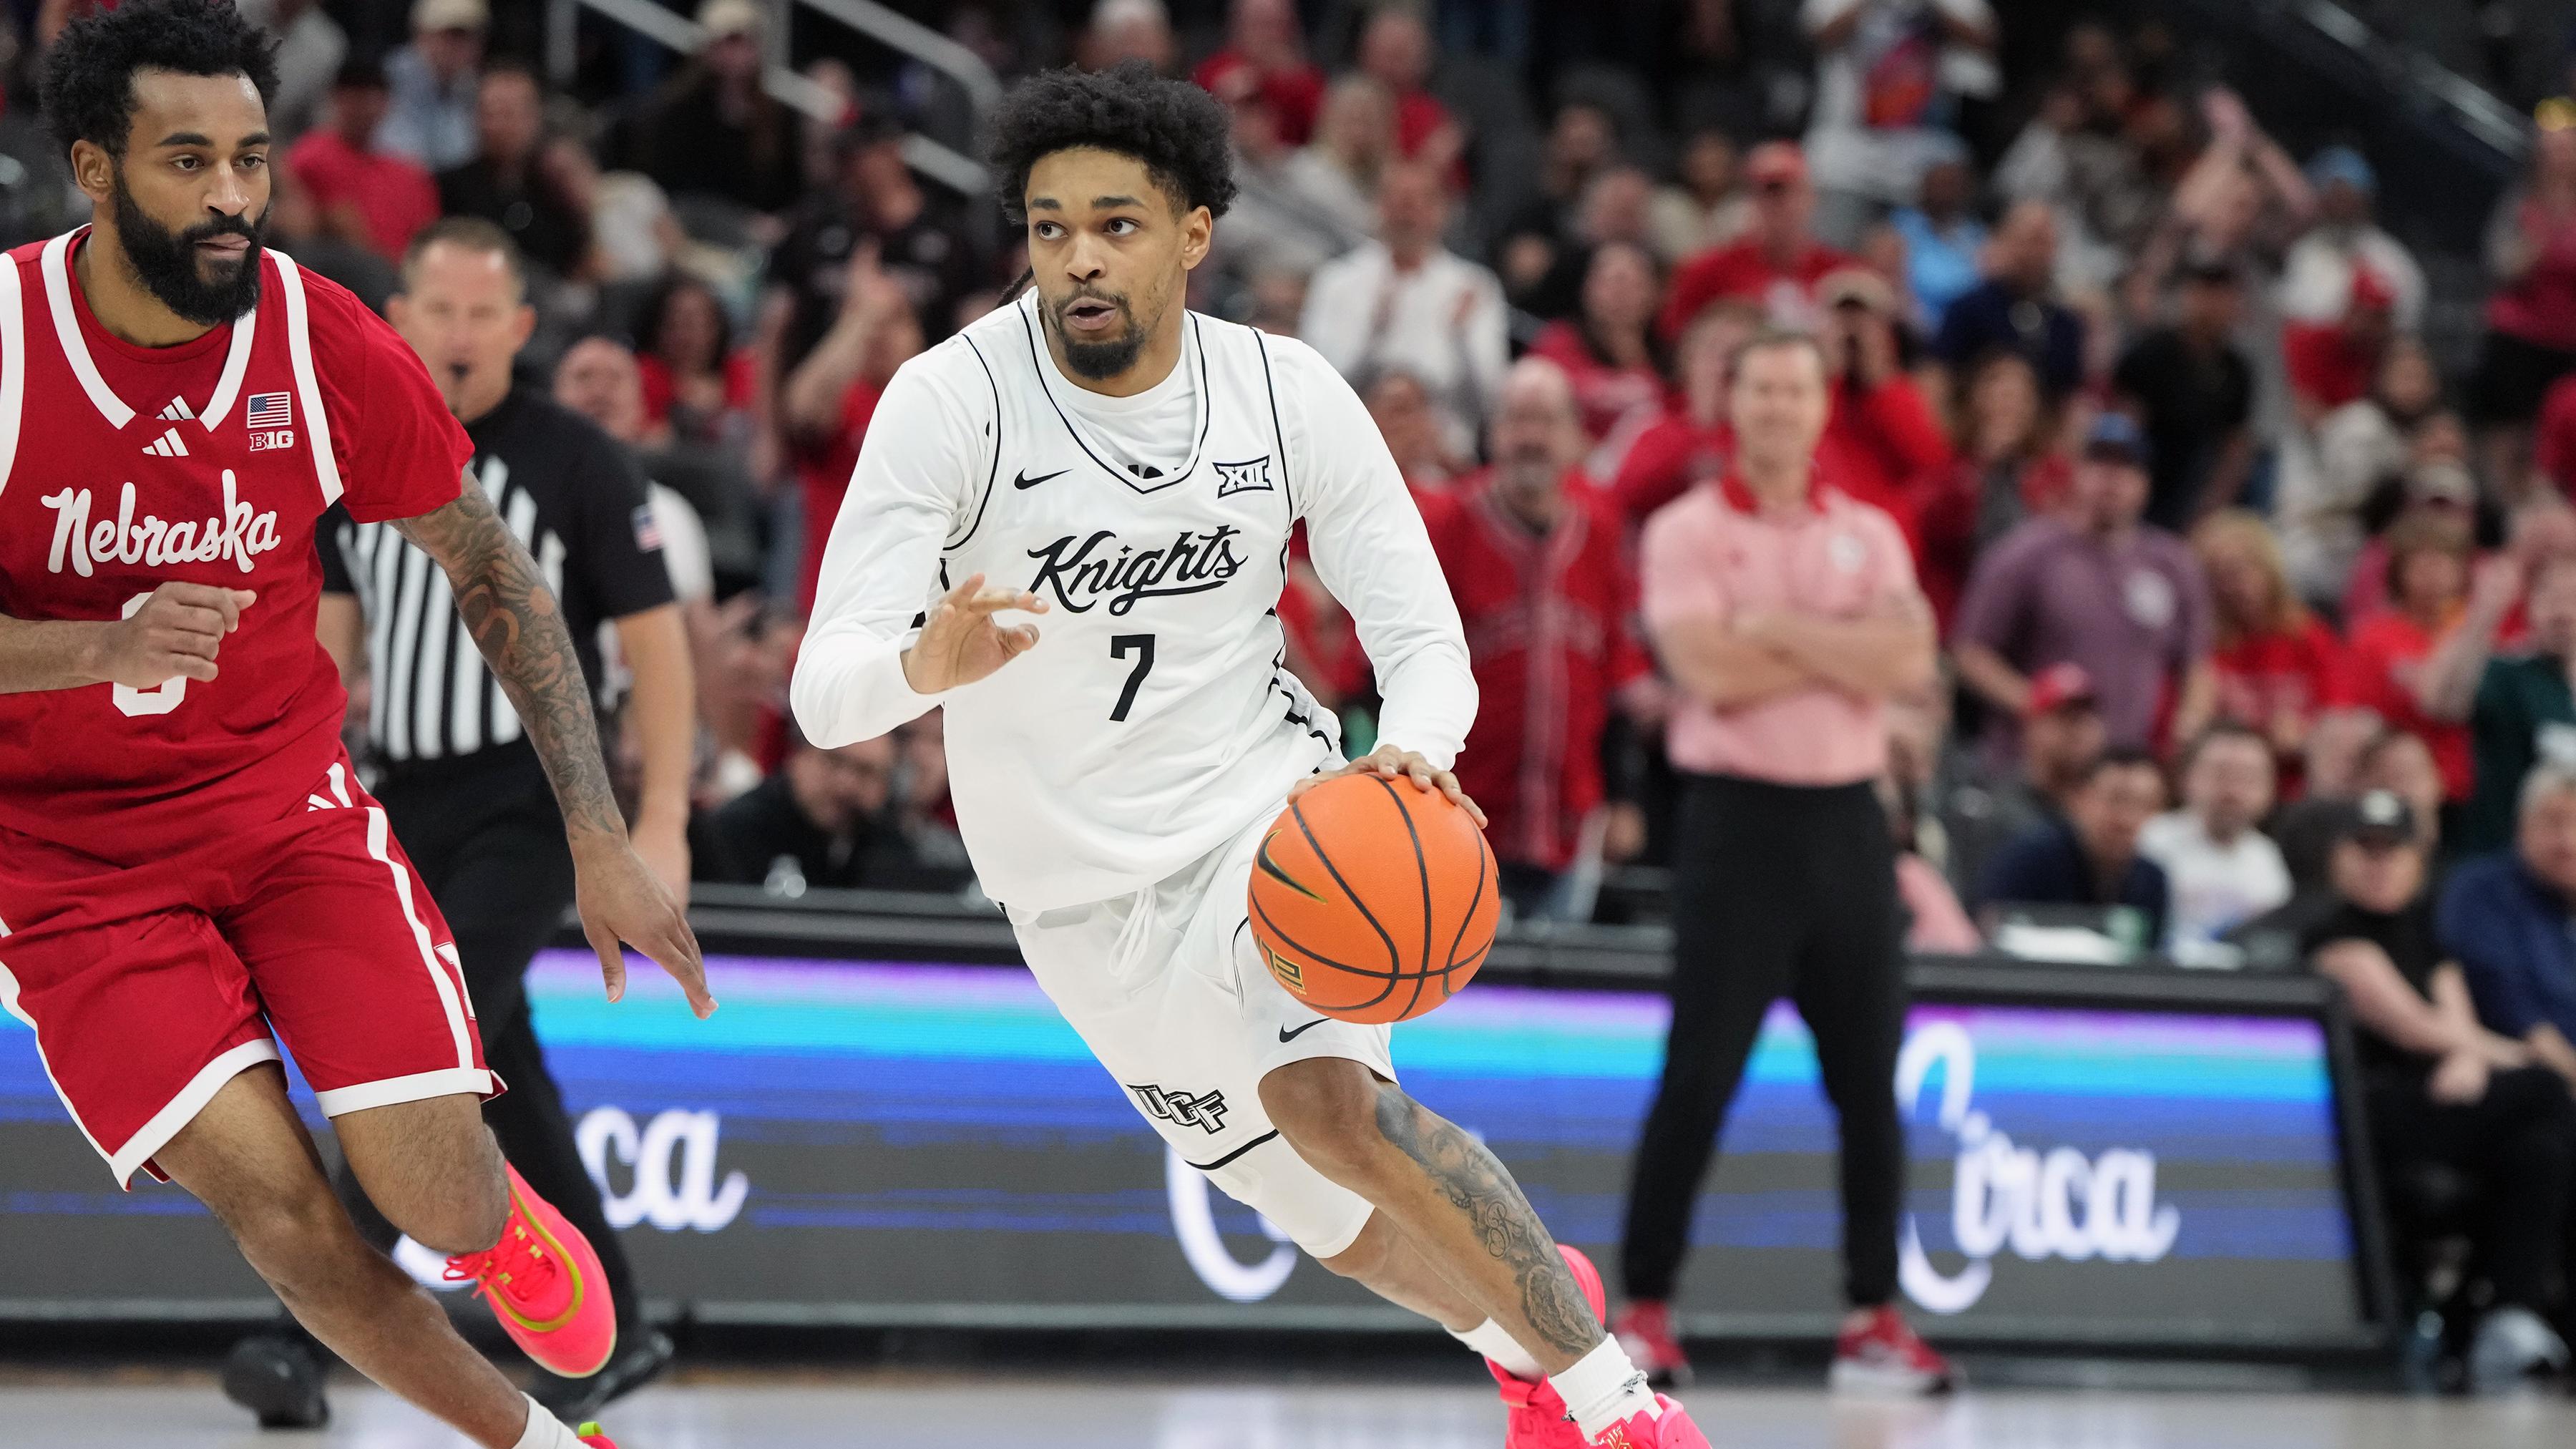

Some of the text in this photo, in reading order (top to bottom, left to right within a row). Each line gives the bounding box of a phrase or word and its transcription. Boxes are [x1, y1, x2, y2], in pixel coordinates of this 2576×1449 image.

[1212, 454, 1274, 499] XII
[41, 469, 280, 577] Nebraska
[1027, 525, 1248, 616] Knights
[1109, 633, 1156, 722] 7
[1126, 1084, 1229, 1135] UCF
